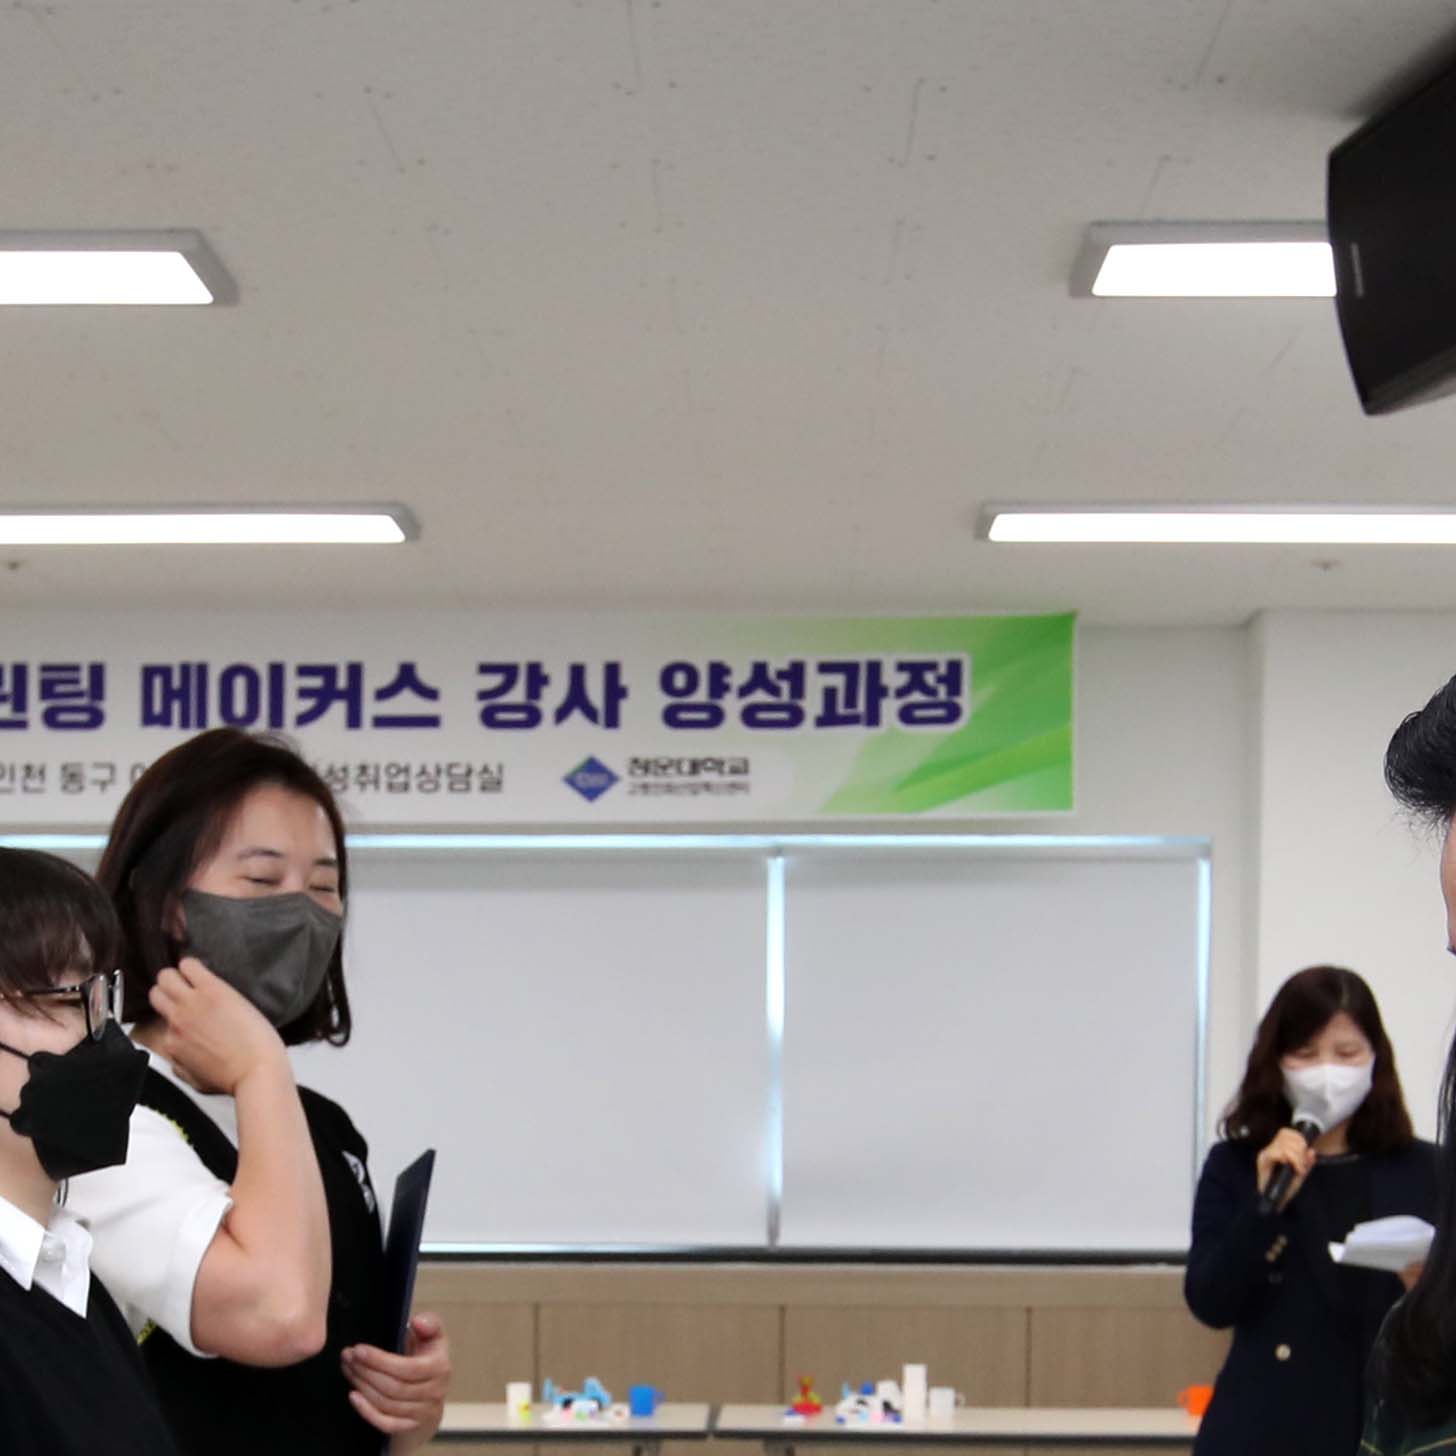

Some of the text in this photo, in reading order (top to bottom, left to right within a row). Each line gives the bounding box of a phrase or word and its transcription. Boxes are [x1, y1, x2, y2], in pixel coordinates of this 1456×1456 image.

[140, 661, 440, 730] 메이커스
[476, 661, 628, 729] 강사
[659, 660, 964, 729] 양성과정
[60, 762, 117, 795] 동구
[320, 762, 504, 794] 성취업상담실
